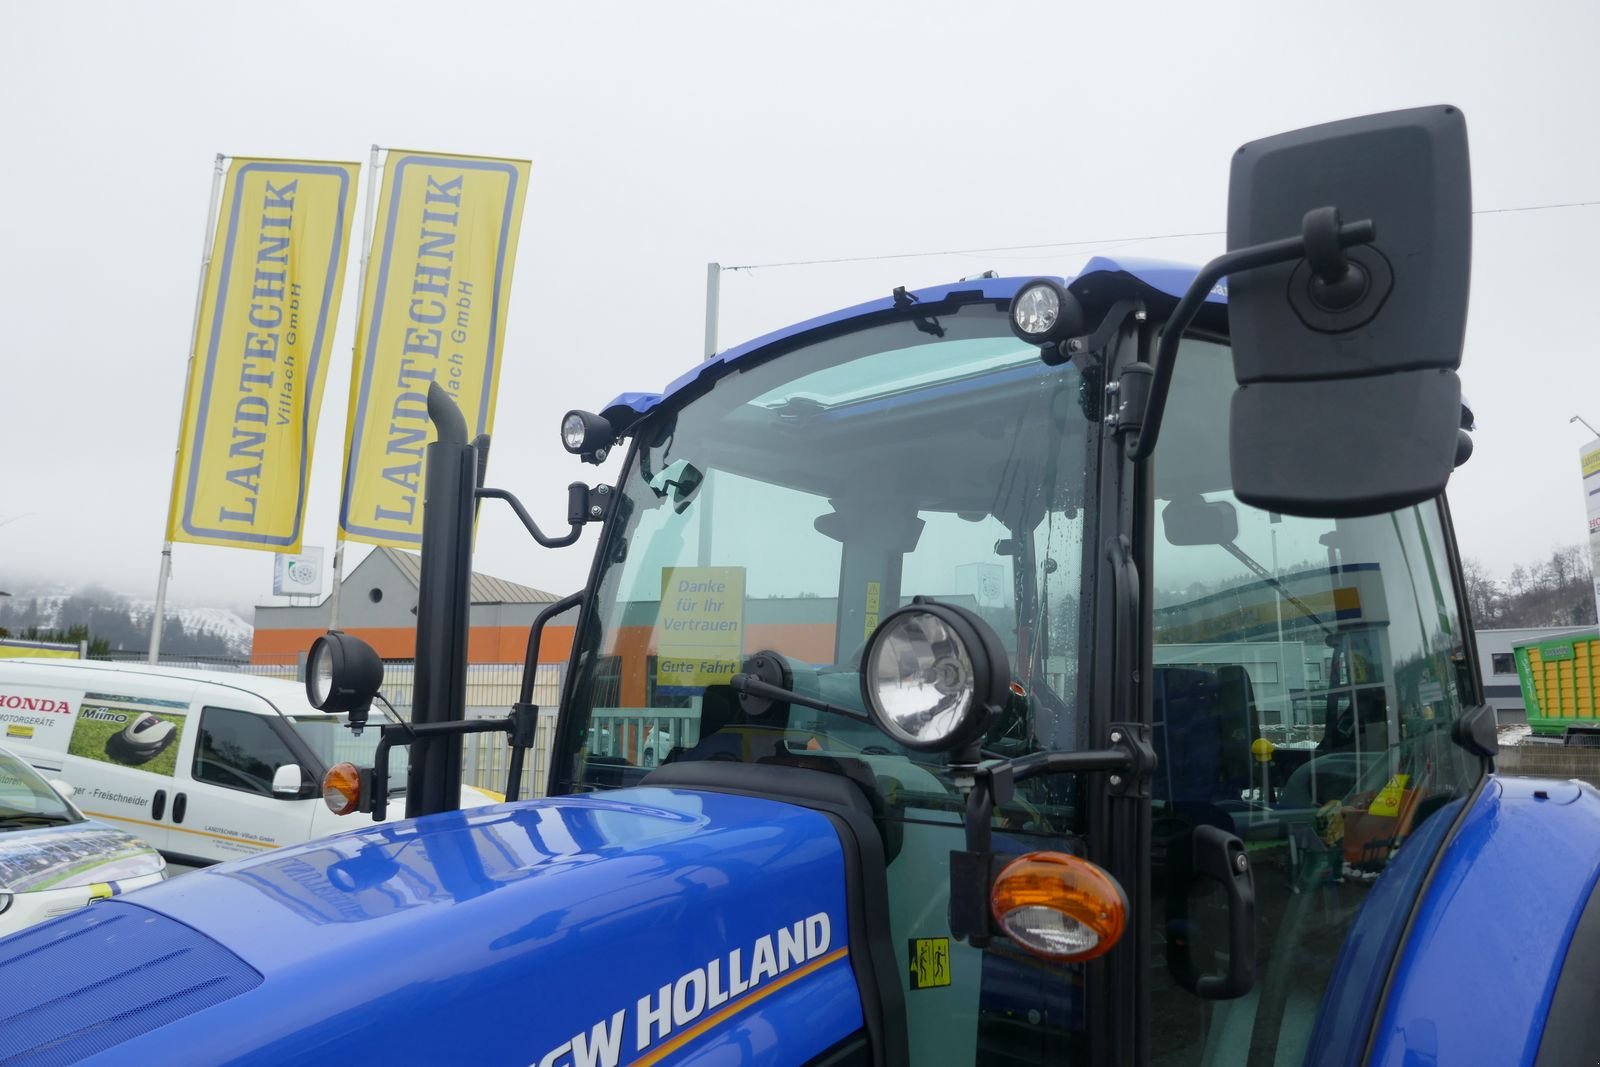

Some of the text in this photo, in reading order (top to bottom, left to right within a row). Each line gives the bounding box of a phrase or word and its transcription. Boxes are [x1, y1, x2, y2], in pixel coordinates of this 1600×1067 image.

[451, 280, 474, 344] GmbH
[218, 178, 299, 526] LANDTECHNIK
[276, 282, 302, 427] Villach GmbH
[374, 174, 464, 526] LANDTECHNIK
[676, 598, 725, 613] für Ihr
[677, 580, 726, 593] Danke
[664, 618, 738, 632] Vertrauen
[661, 660, 736, 674] Gute Fahrt
[82, 708, 128, 723] Miimo
[636, 911, 831, 1051] HOLLAND
